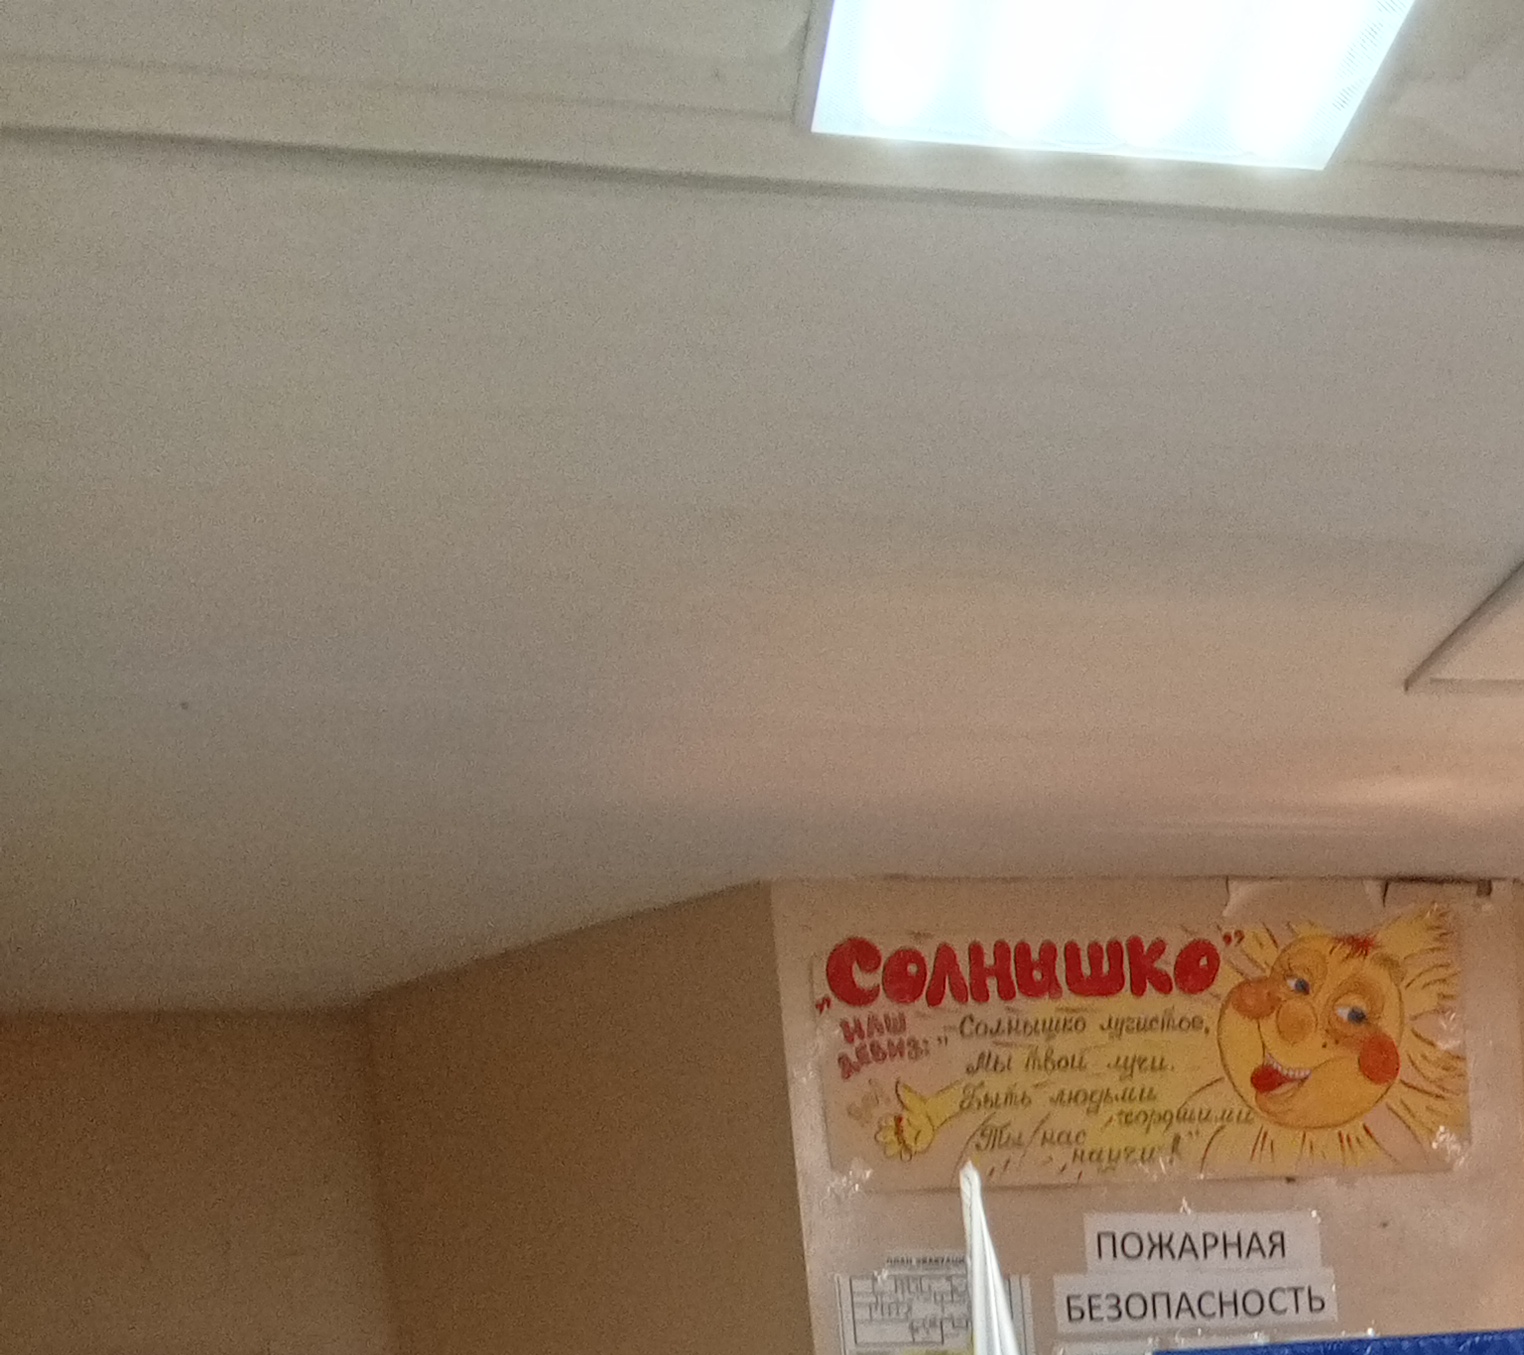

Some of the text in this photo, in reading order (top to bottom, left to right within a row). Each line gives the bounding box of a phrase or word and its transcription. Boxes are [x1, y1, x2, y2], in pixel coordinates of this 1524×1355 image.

[966, 1051, 1012, 1074] Мы
[1050, 1087, 1158, 1115] людьми
[1041, 1127, 1087, 1147] нас
[1096, 1230, 1286, 1261] ПОЖАРНАЯ
[1065, 1286, 1326, 1324] БЕЗОПАСНОСТЬ
